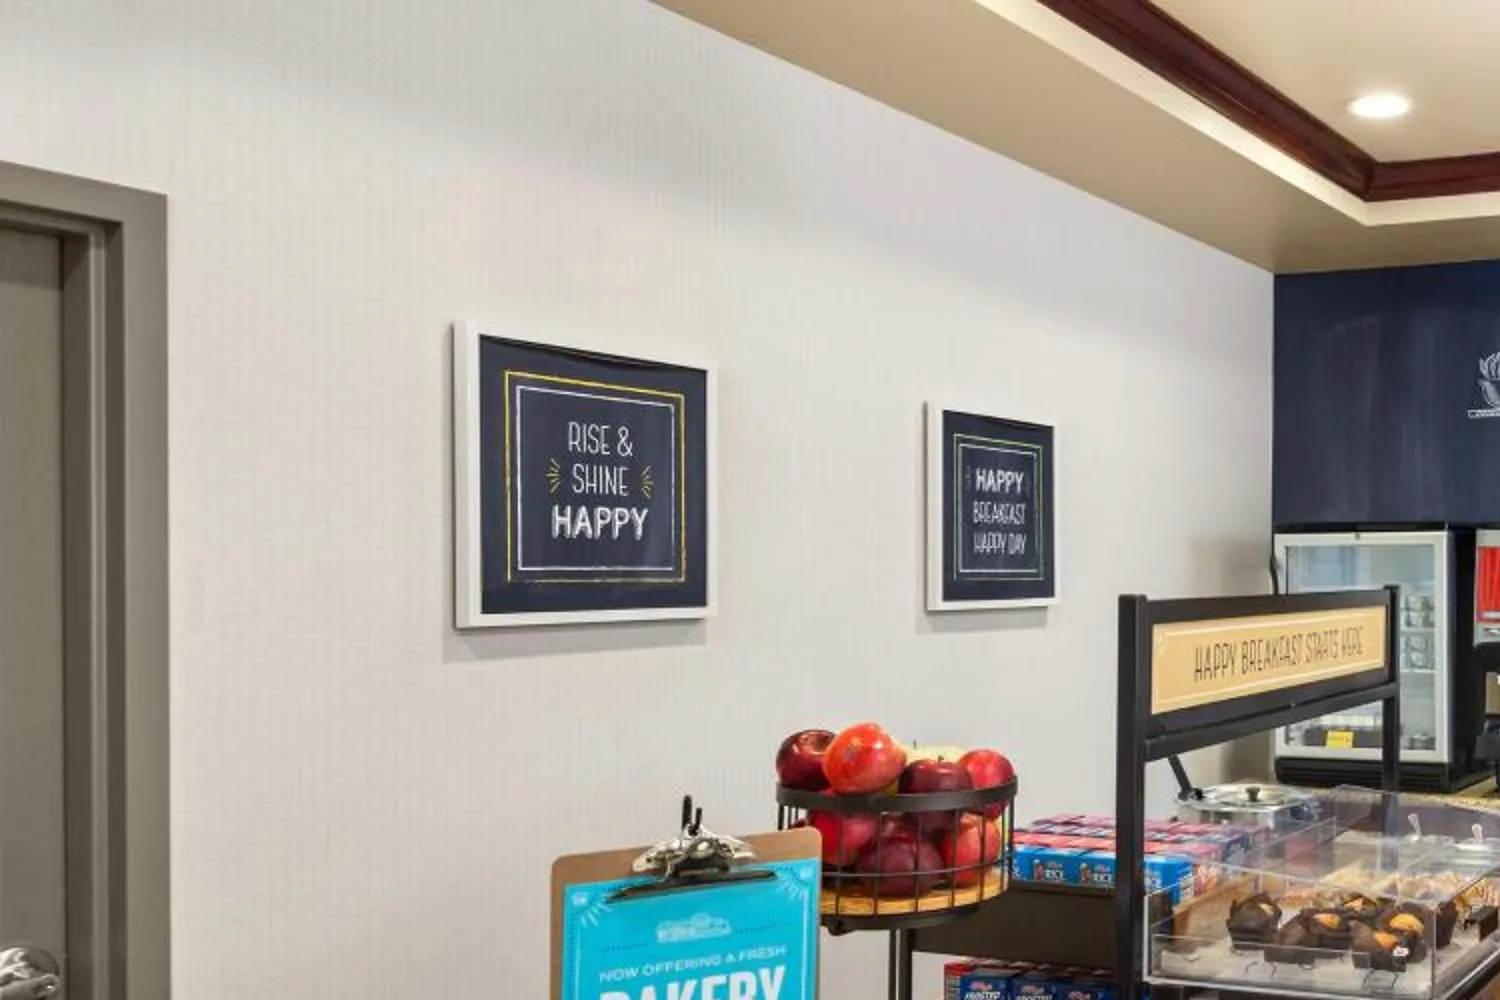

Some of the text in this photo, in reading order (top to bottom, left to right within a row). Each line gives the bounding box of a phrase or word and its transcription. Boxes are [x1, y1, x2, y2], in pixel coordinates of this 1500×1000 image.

[567, 421, 633, 457] RISE &
[572, 463, 630, 497] SHINE
[975, 467, 1024, 494] HAPPY
[551, 504, 649, 541] HAPPY
[973, 501, 1025, 525] BREAKFAST
[973, 531, 1007, 555] HAPPY
[1194, 640, 1238, 683] HAPPY
[1241, 633, 1304, 675] BREAKFAST
[1305, 629, 1338, 664] STARTS
[599, 945, 787, 983] NOW OFFERING A FRESH
